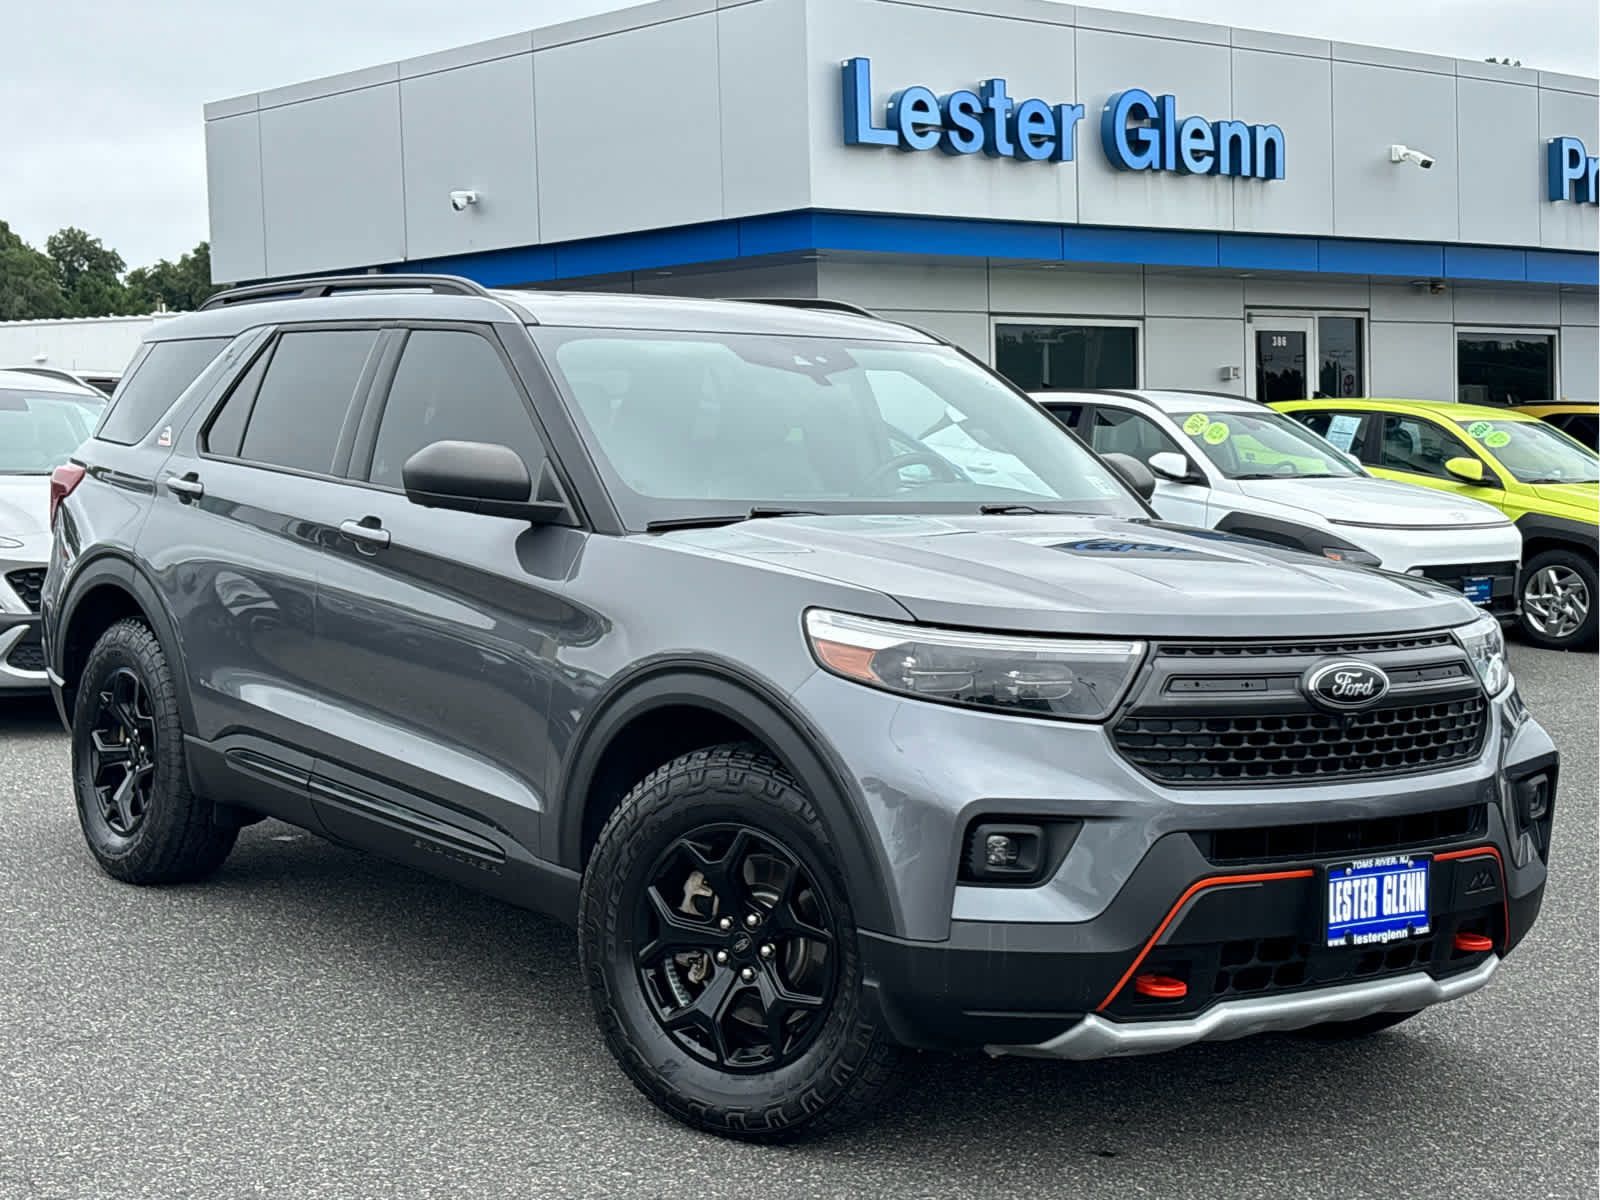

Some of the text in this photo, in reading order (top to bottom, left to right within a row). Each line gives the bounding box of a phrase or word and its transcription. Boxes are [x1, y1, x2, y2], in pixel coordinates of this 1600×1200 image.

[842, 57, 1286, 180] Lester Glenn
[1272, 336, 1287, 347] 386
[1332, 672, 1375, 696] Ford
[1352, 859, 1373, 870] TOMS
[1328, 871, 1426, 924] LESTER GLENN
[1353, 929, 1408, 945] lesterglenn
